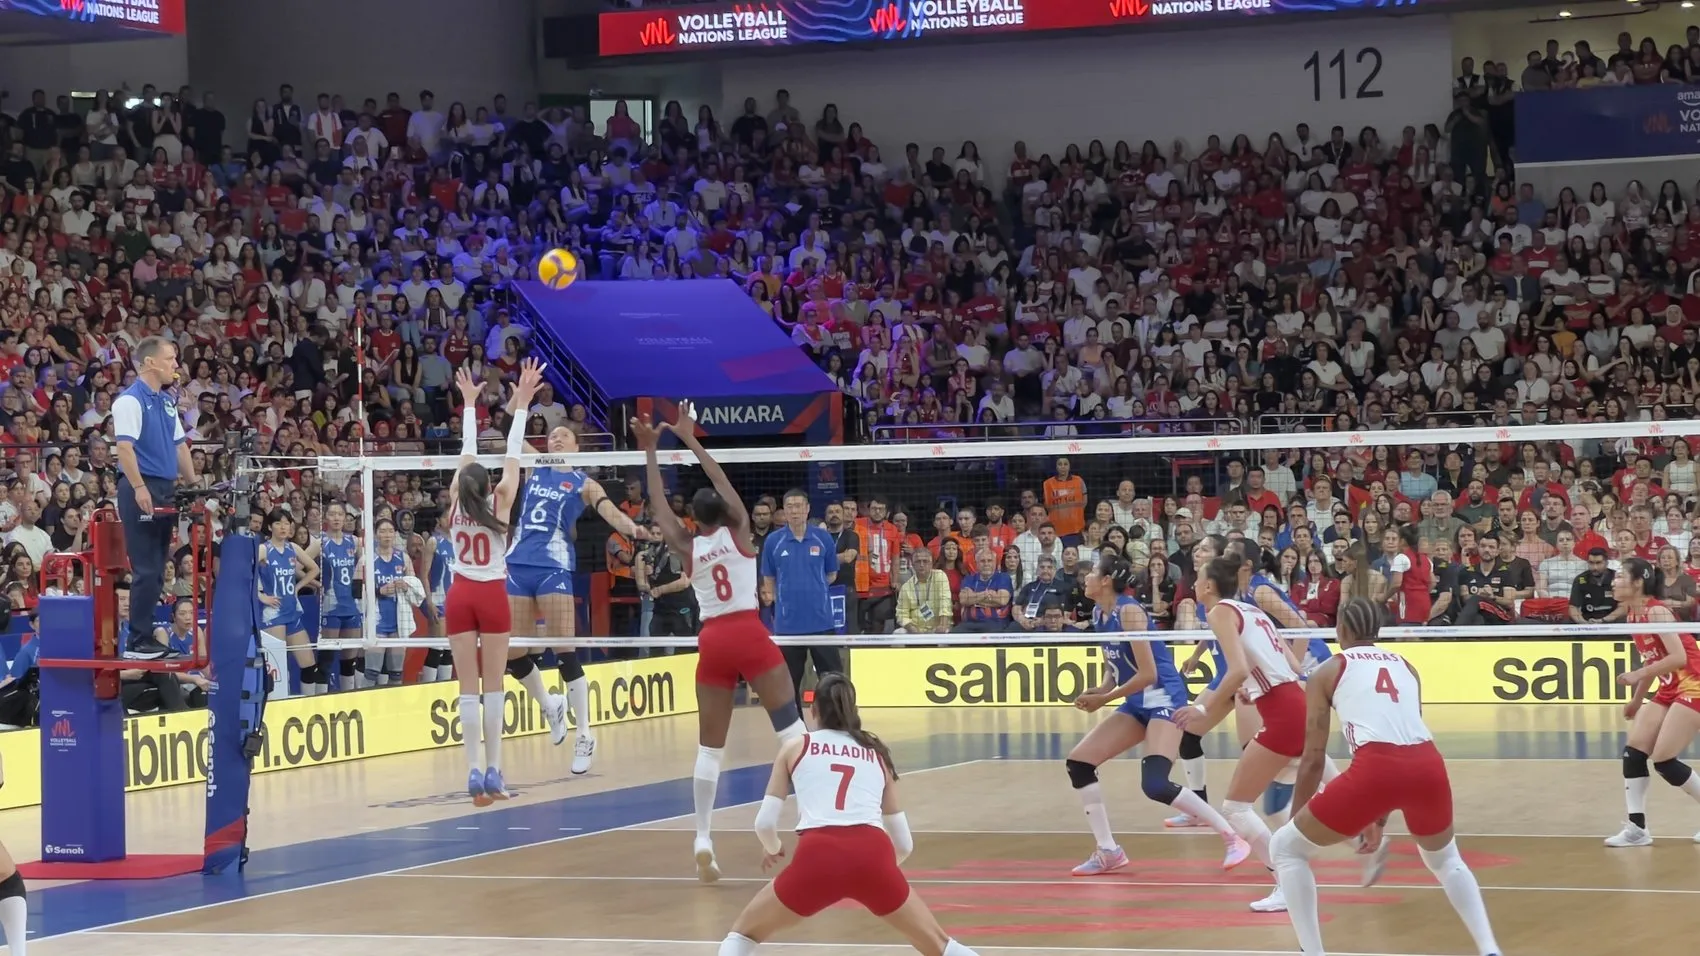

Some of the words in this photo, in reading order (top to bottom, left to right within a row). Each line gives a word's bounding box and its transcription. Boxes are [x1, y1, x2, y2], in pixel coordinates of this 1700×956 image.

[87, 2, 125, 19] NATIONS
[126, 8, 159, 24] LEAGUE
[910, 0, 1023, 17] VOLLEYBALL
[1152, 0, 1212, 15] NATIONS
[1217, 0, 1271, 11] LEAGUE
[678, 10, 787, 31] VOLLEYBALL
[911, 16, 968, 30] NATIONS
[973, 12, 1024, 27] LEAGUE
[678, 30, 734, 44] NATIONS
[738, 26, 788, 41] LEAGUE
[1304, 47, 1383, 101] 112
[700, 404, 785, 425] ANKARA
[528, 484, 565, 502] Haier
[530, 500, 549, 524] 6
[455, 530, 491, 566] 20
[333, 558, 355, 567] Haier
[279, 575, 295, 596] 16
[341, 567, 351, 586] 8
[711, 563, 733, 602] 8
[1346, 653, 1399, 663] VARGAS
[1375, 667, 1400, 704] 4
[810, 742, 875, 763] BALADIN
[830, 763, 855, 811] 7
[53, 846, 84, 855] Senoh
